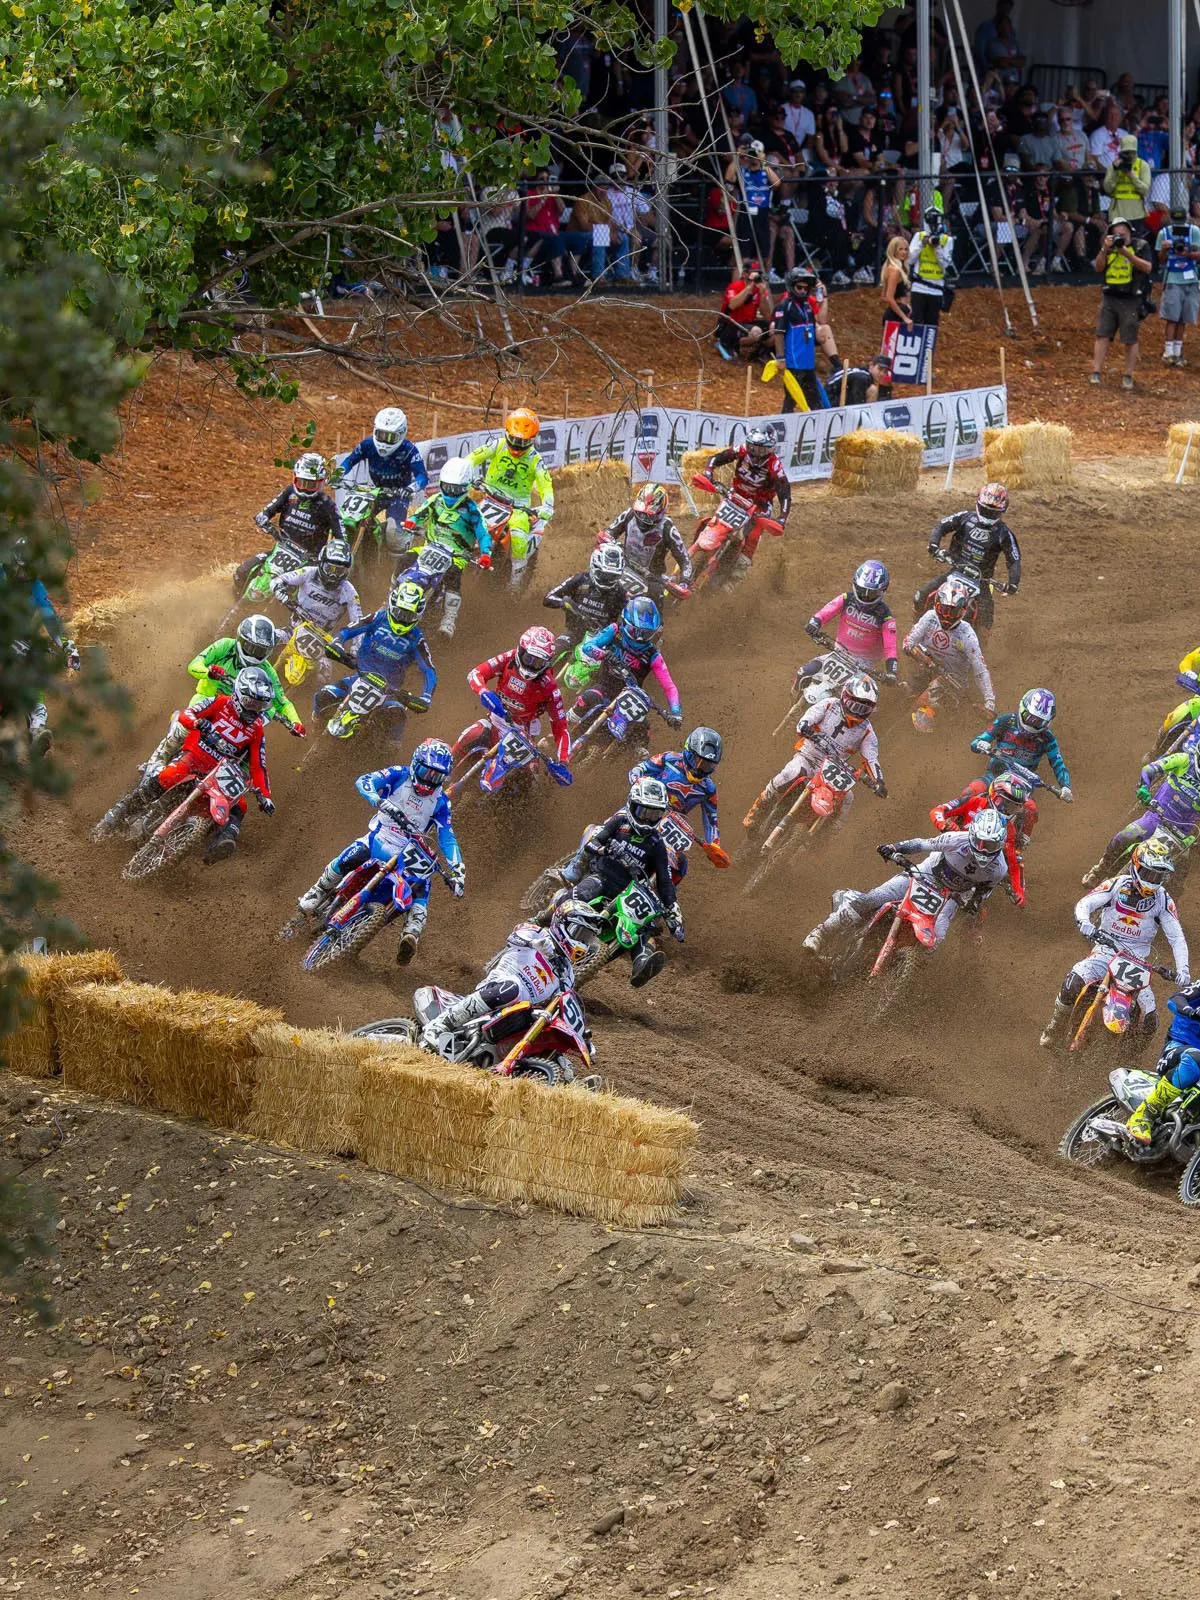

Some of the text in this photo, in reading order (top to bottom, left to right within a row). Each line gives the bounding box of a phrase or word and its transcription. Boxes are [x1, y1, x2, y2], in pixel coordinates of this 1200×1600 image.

[893, 333, 921, 376] 30
[717, 506, 747, 529] 502
[420, 550, 449, 571] 456
[823, 660, 854, 686] 667
[350, 685, 380, 712] 20
[618, 693, 647, 721] 63
[213, 718, 250, 743] FLY
[506, 738, 530, 762] 54
[216, 767, 246, 797] 76
[823, 764, 852, 789] 83
[660, 820, 690, 852] 563
[402, 848, 434, 875] 52
[624, 891, 653, 920] 69
[911, 886, 942, 914] 28
[1111, 922, 1126, 933] Red
[1126, 926, 1142, 937] Bull
[523, 965, 545, 995] Red Bull
[1114, 961, 1145, 988] 14
[563, 997, 583, 1034] 51
